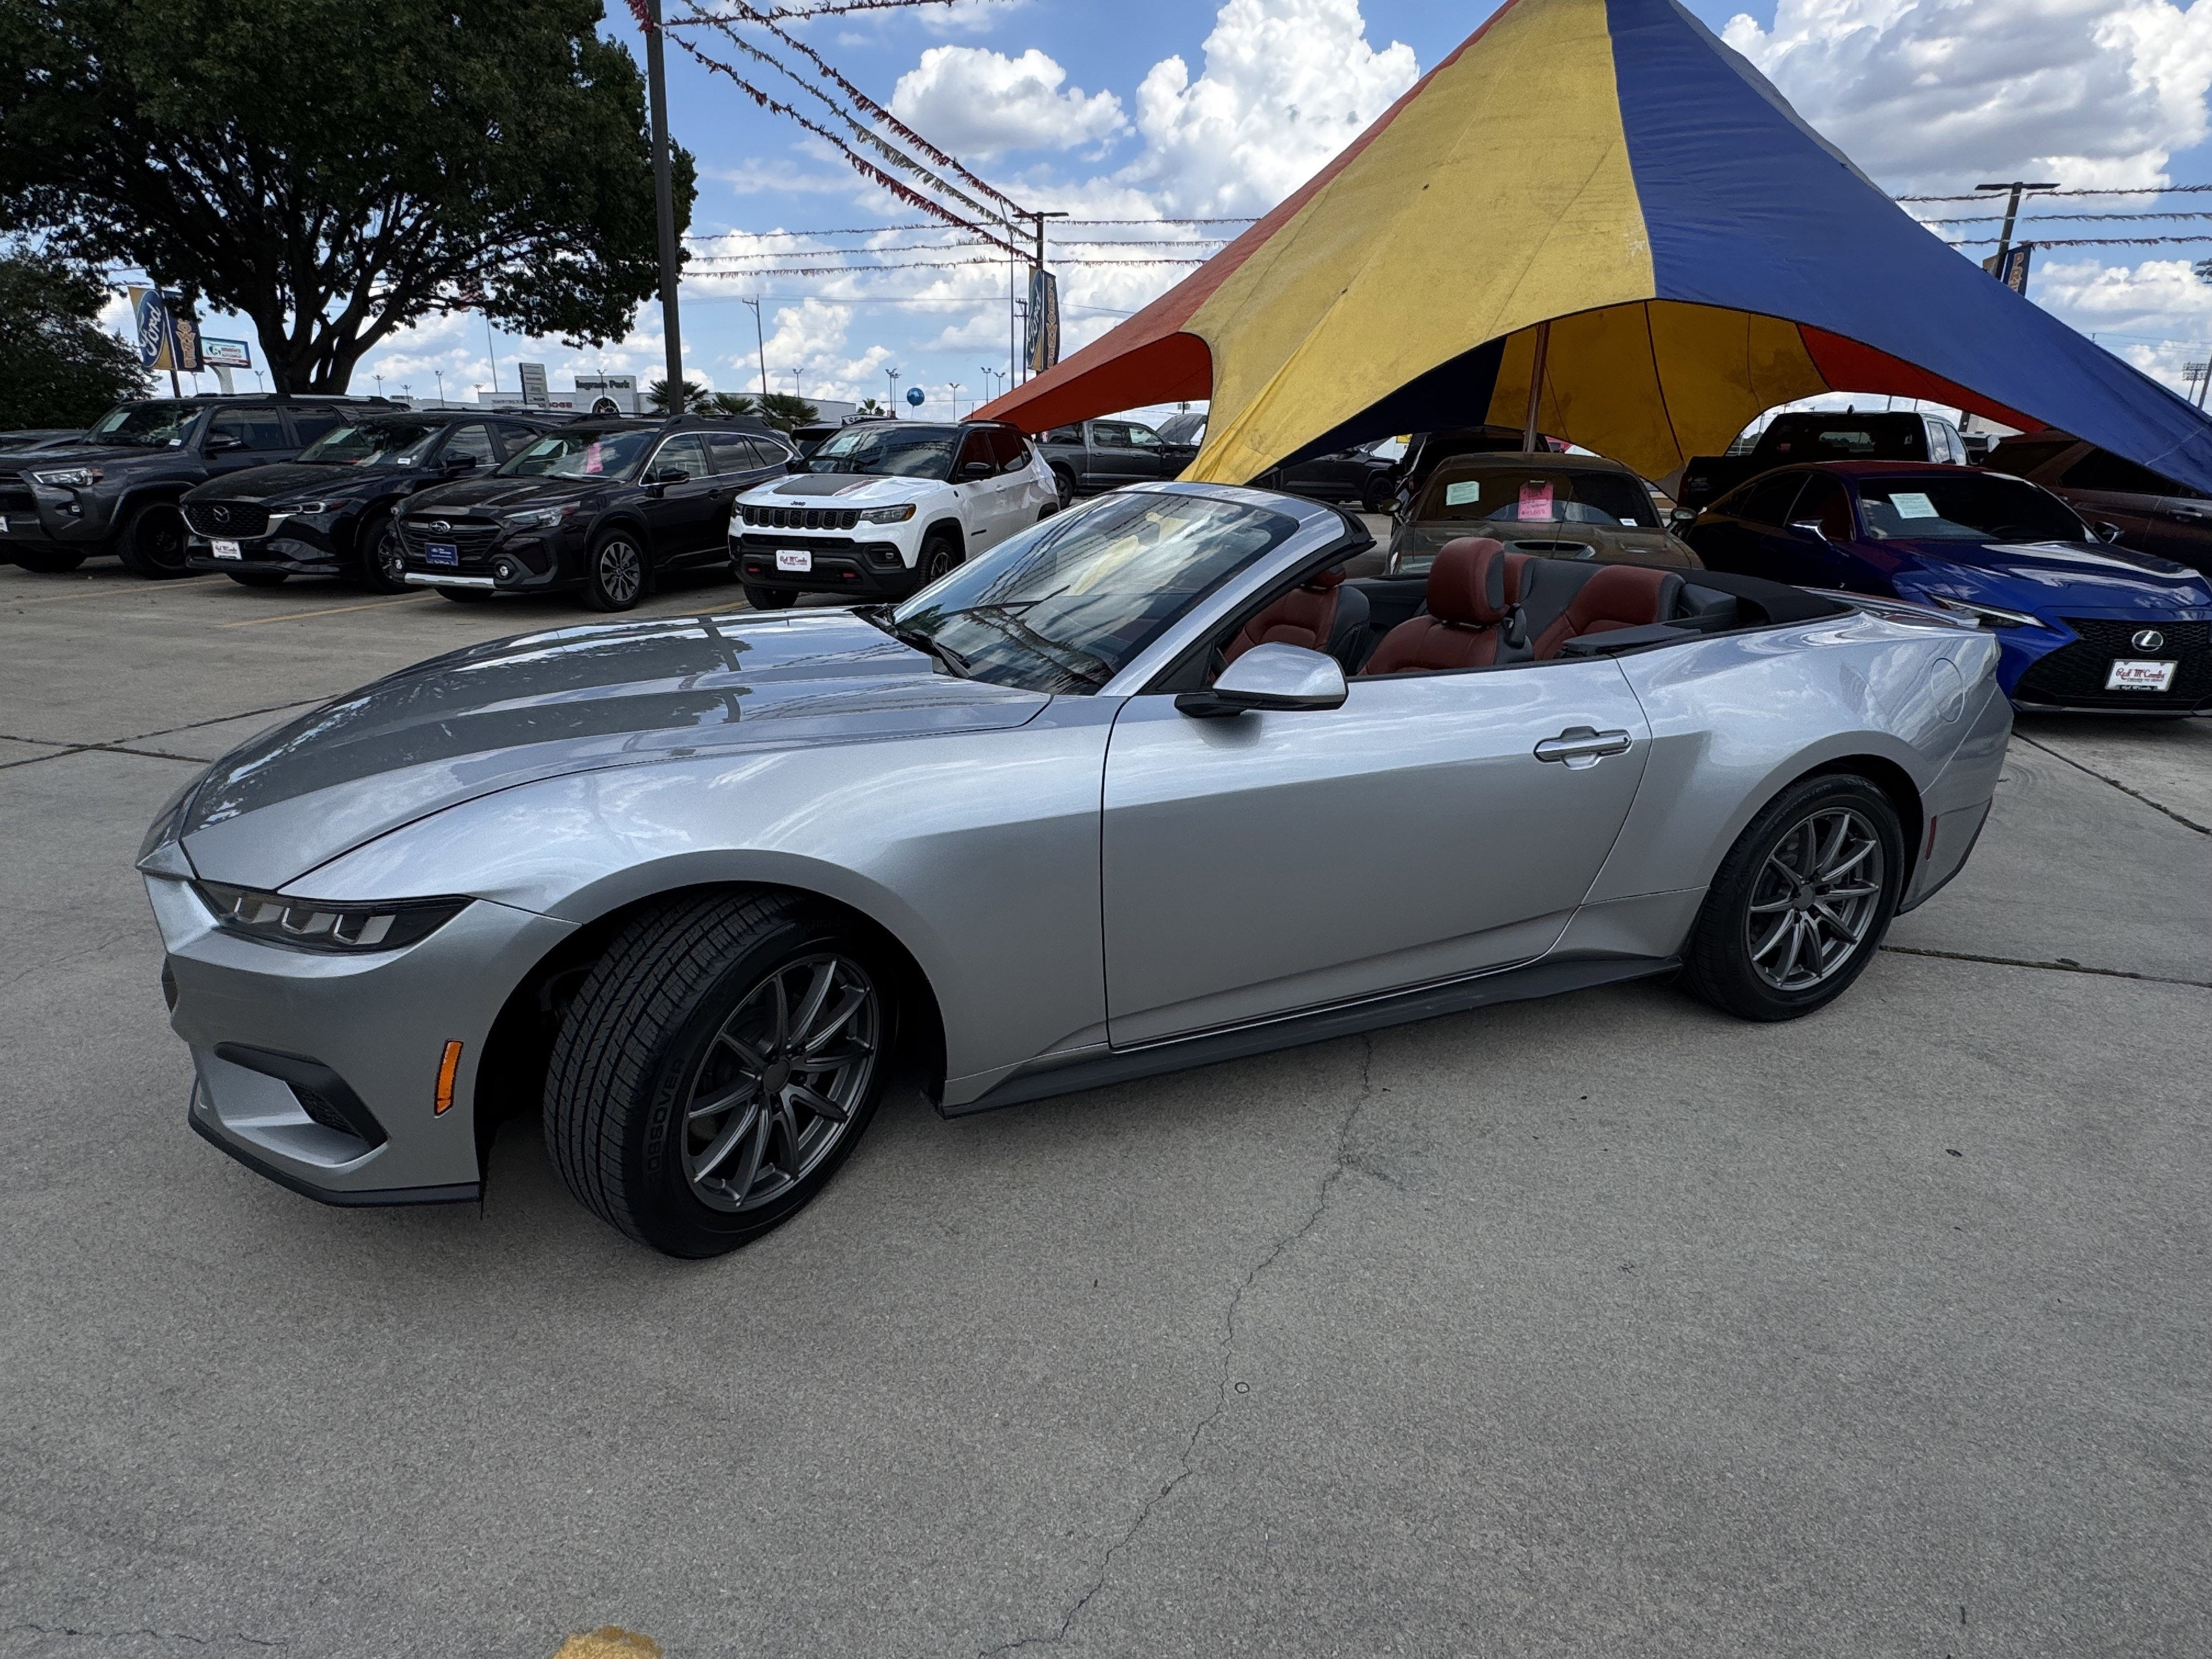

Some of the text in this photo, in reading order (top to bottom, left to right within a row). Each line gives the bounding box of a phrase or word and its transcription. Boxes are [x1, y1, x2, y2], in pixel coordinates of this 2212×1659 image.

[139, 302, 162, 357] Ford
[176, 318, 198, 369] OWNED
[1028, 285, 1041, 354] Ford
[610, 380, 630, 388] Park
